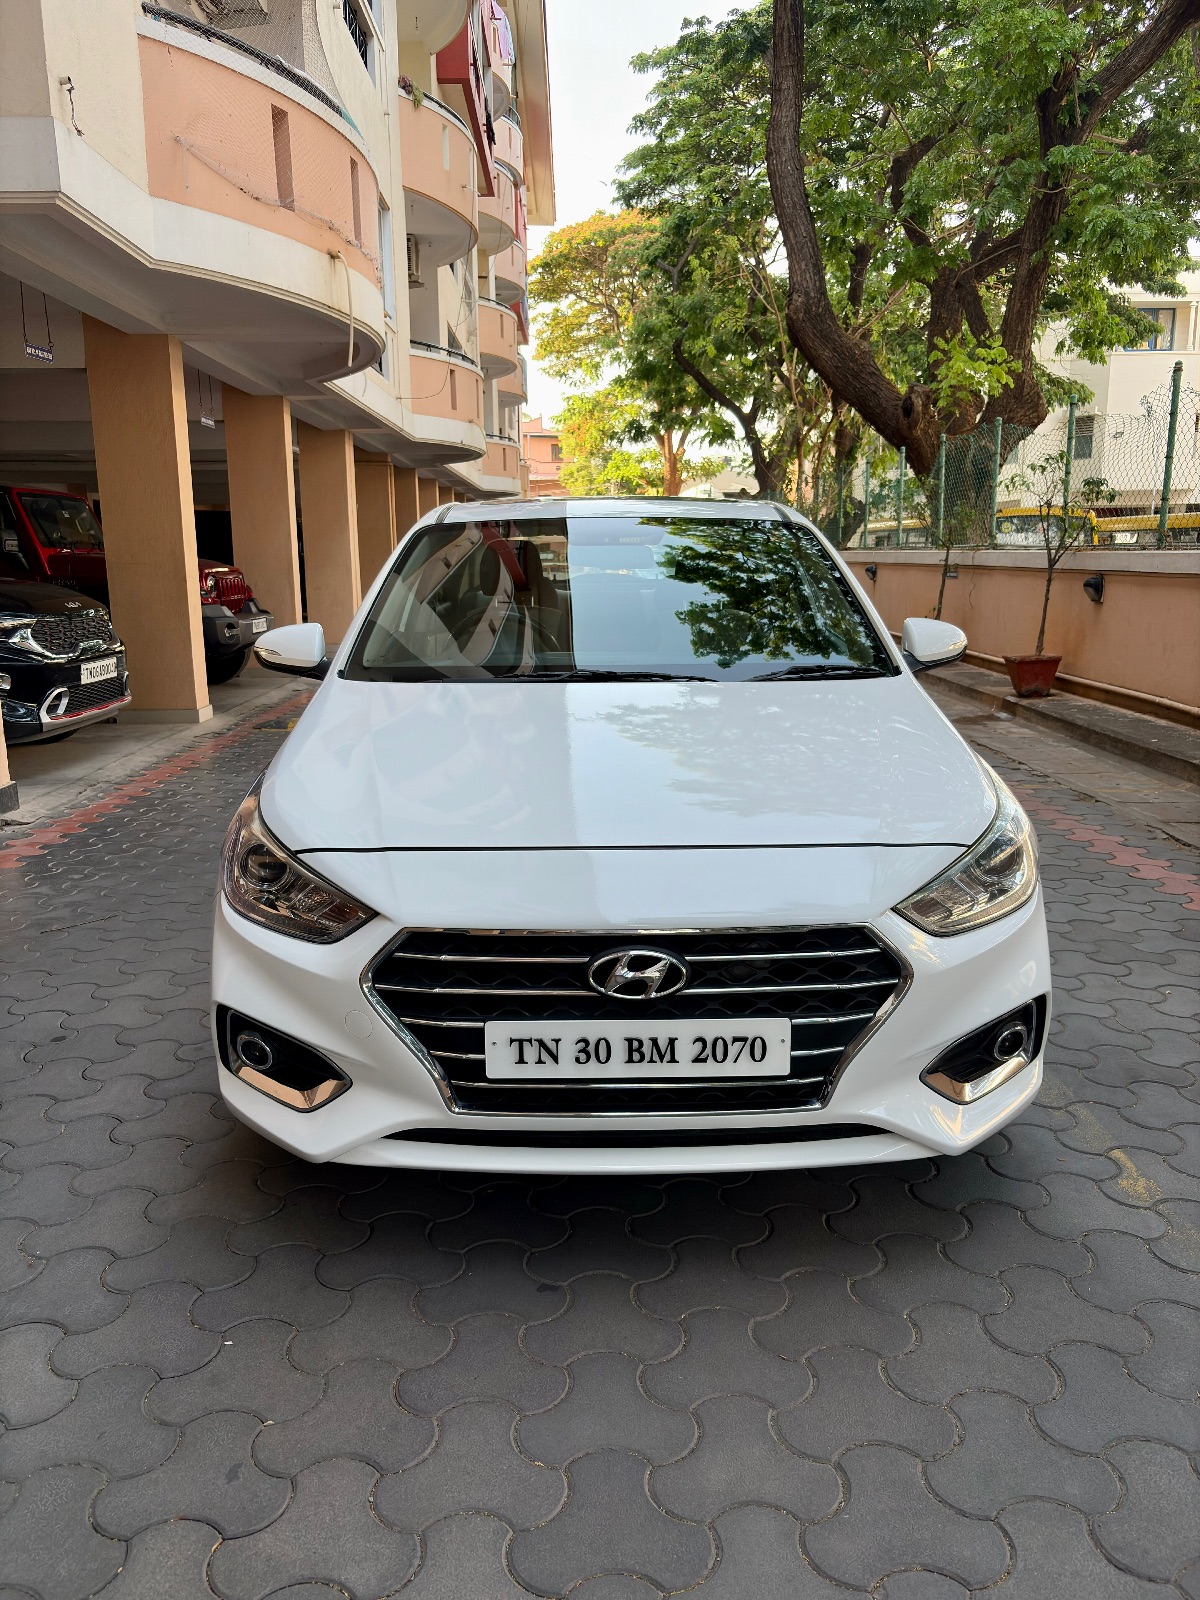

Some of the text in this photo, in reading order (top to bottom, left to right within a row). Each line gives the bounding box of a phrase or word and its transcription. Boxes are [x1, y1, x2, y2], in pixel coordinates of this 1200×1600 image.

[510, 1036, 767, 1065] TN 30 BM 2070
